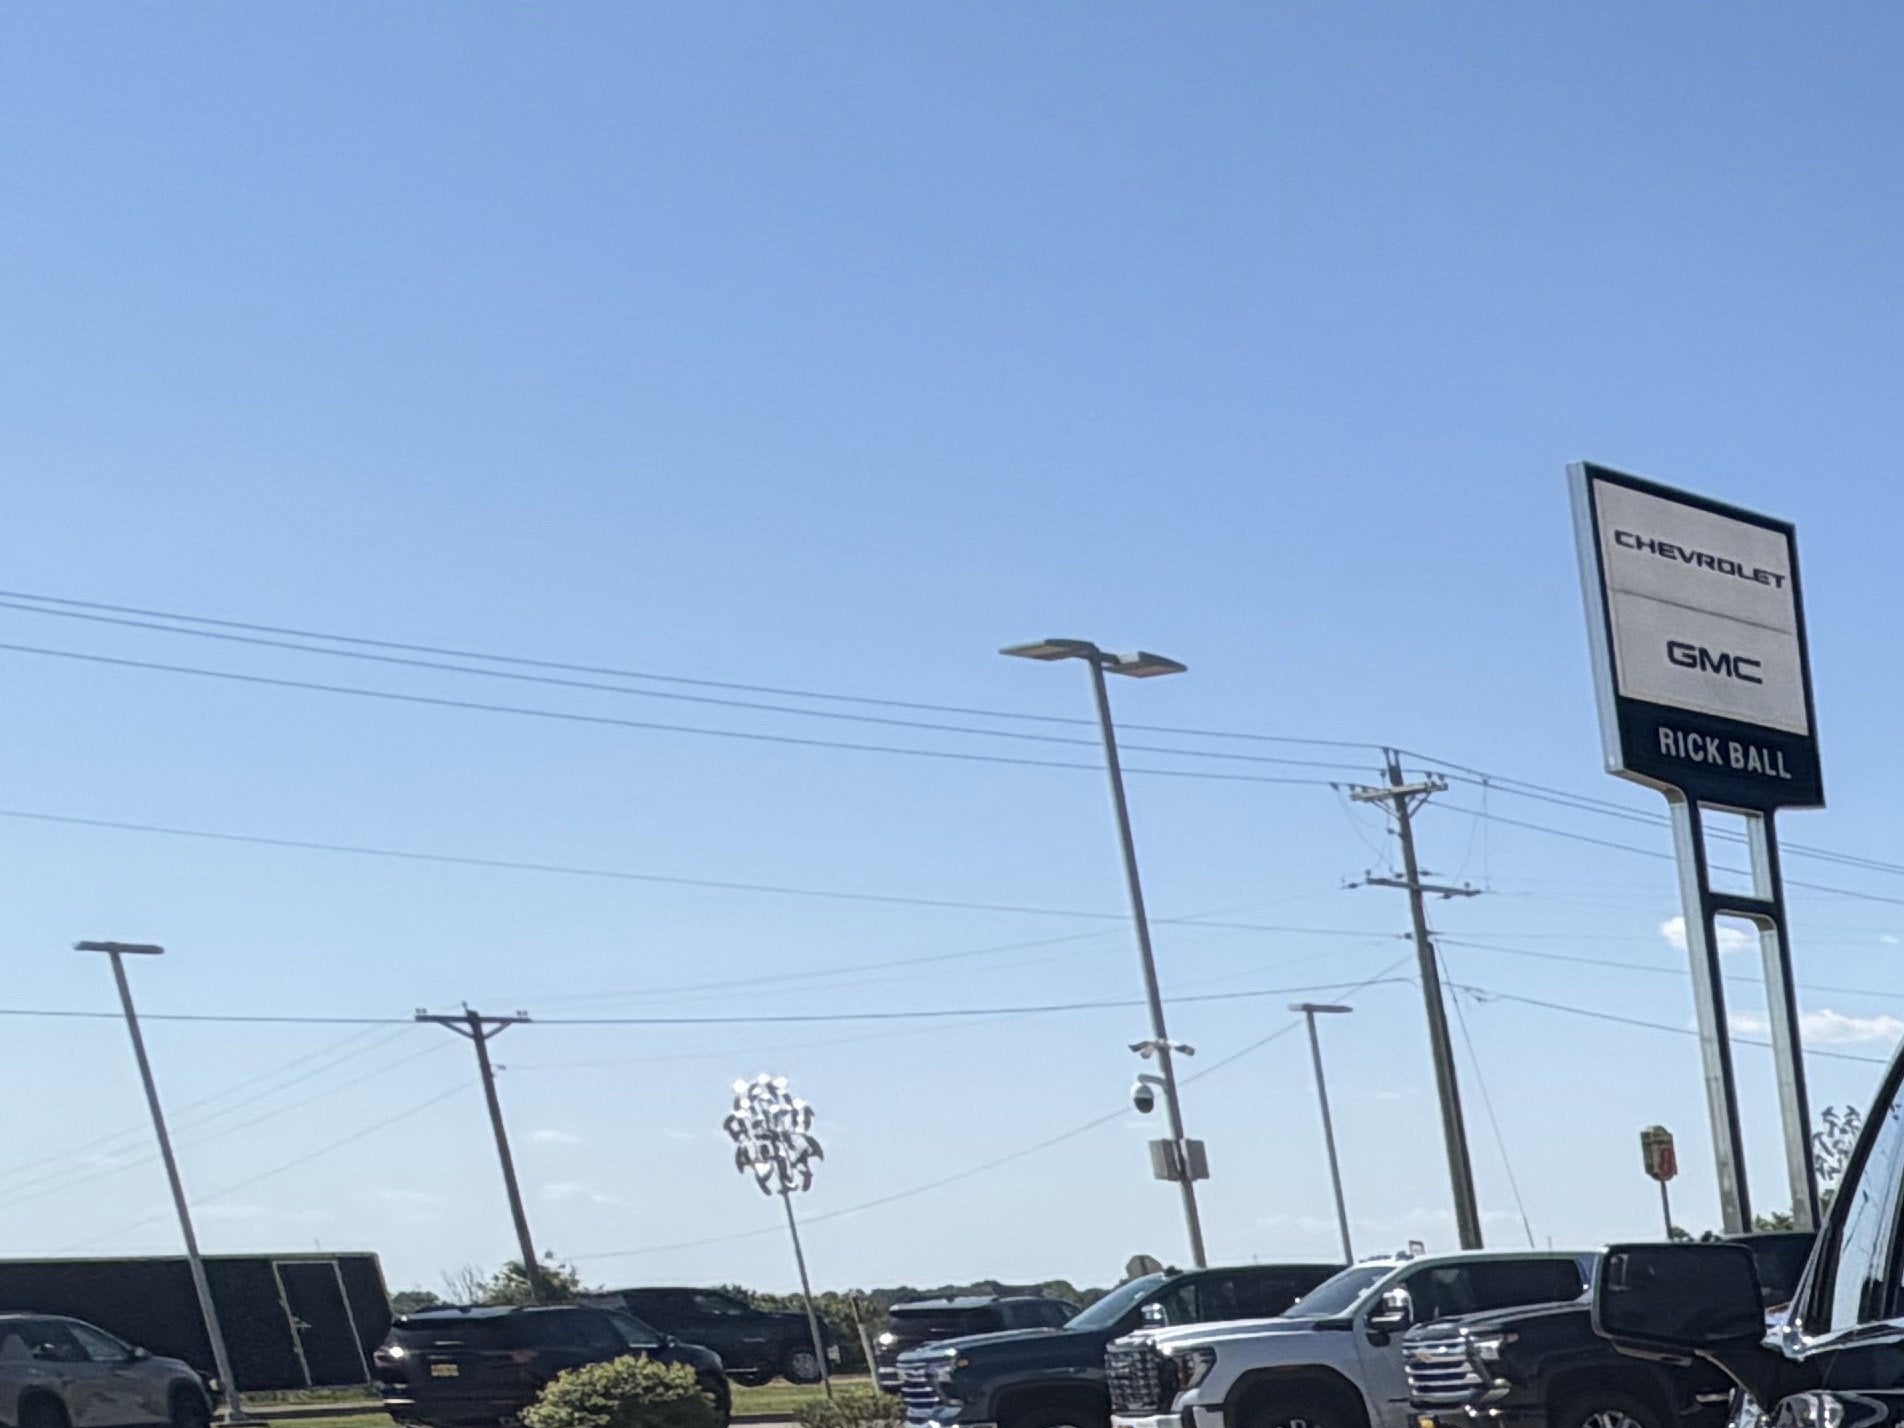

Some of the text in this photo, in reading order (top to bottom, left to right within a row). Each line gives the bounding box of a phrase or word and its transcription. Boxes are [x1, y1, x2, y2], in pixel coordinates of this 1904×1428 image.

[1614, 530, 1786, 588] CHEVROLET
[1667, 640, 1763, 685] GMC
[1658, 726, 1792, 779] RICK BALL
